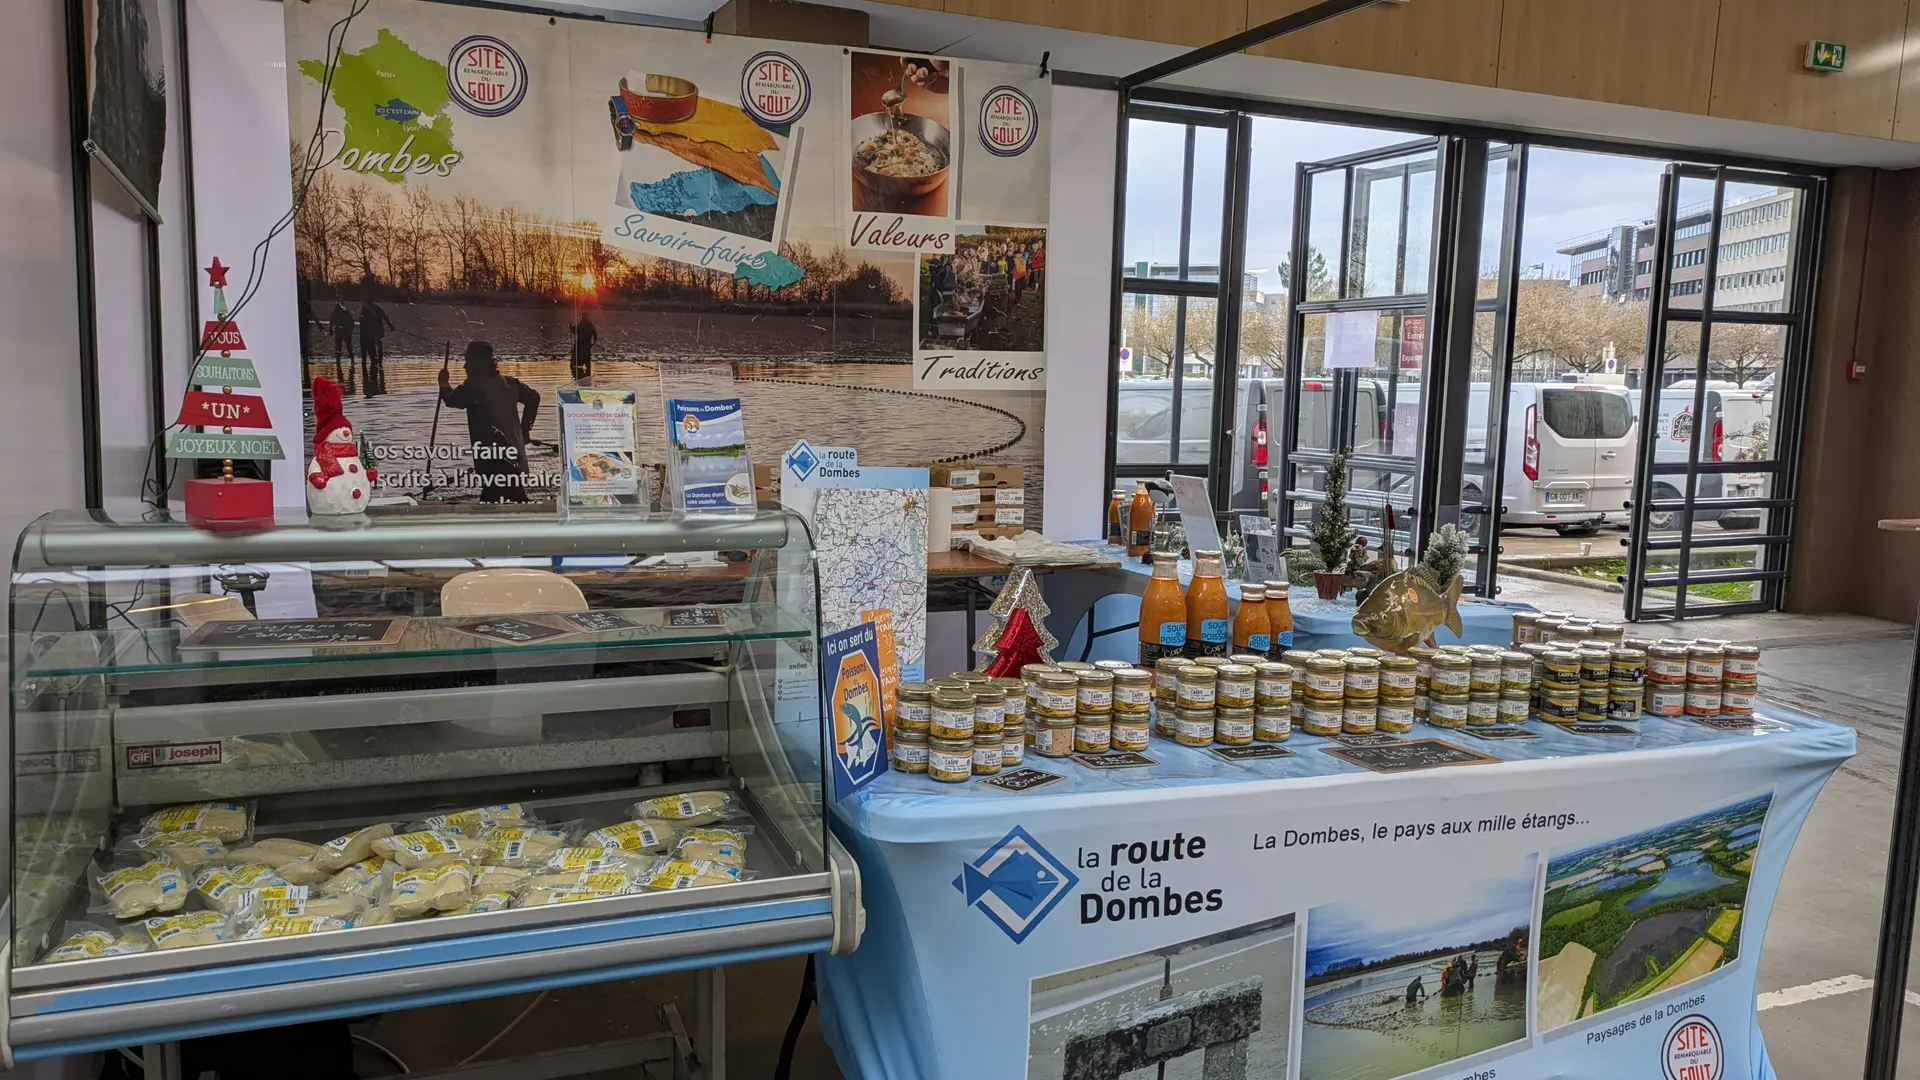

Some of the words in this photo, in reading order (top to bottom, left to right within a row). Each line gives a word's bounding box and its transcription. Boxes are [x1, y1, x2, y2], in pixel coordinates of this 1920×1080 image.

[467, 48, 505, 69] SITE
[376, 70, 392, 78] Paris
[463, 68, 508, 77] REMARQUABLE
[758, 62, 792, 83] SITE
[468, 82, 505, 102] GOUT
[755, 82, 795, 90] REMARQUABLE
[758, 95, 792, 113] GOUT
[994, 96, 1022, 116] SITE
[991, 114, 1025, 122] REMARQUABLE
[404, 124, 418, 132] Lyon
[992, 127, 1022, 144] GOUT
[305, 130, 462, 178] Dombes
[850, 214, 950, 250] Valeurs
[614, 214, 767, 269] Savoir-faire
[208, 331, 240, 345] VOUS
[196, 365, 254, 381] SOUHAITONS
[920, 355, 1044, 381] Traditions
[677, 404, 700, 413] Poissons
[176, 438, 237, 454] JOYEUX
[240, 440, 280, 455] NOËL
[370, 443, 398, 461] os
[402, 440, 519, 461] savoir-faire
[819, 452, 826, 460] la
[828, 450, 855, 460] route
[820, 466, 861, 478] Dombes
[826, 460, 835, 468] de
[836, 460, 843, 468] la
[436, 468, 449, 488] à
[454, 468, 563, 488] l'inventaire
[826, 639, 837, 657] Ici
[838, 636, 849, 652] on
[850, 633, 864, 649] sert
[864, 628, 874, 643] du
[1160, 635, 1186, 644] POISSO
[1202, 632, 1228, 641] POISSO
[842, 662, 867, 681] Poissons
[844, 682, 869, 702] Dombes
[170, 745, 218, 761] joseph
[1253, 833, 1277, 850] La
[1284, 826, 1365, 847] Dombes,
[1372, 822, 1389, 840] le
[1393, 822, 1436, 842] pays
[1440, 820, 1473, 835] aux
[1478, 814, 1517, 833] mille
[1521, 812, 1590, 831] étangs...
[1078, 847, 1100, 869] la
[1110, 832, 1207, 867] route
[1100, 870, 1131, 893] de
[1140, 867, 1162, 889] la
[1080, 886, 1224, 925] Dombes
[1586, 1019, 1637, 1045] Paysages
[1639, 1014, 1652, 1027] de
[1654, 1010, 1664, 1021] la
[1666, 993, 1706, 1017] Dombes
[1676, 1025, 1709, 1051] SITE
[1674, 1048, 1712, 1060] REMARQUABLE
[1680, 1064, 1711, 1080] GOUT
